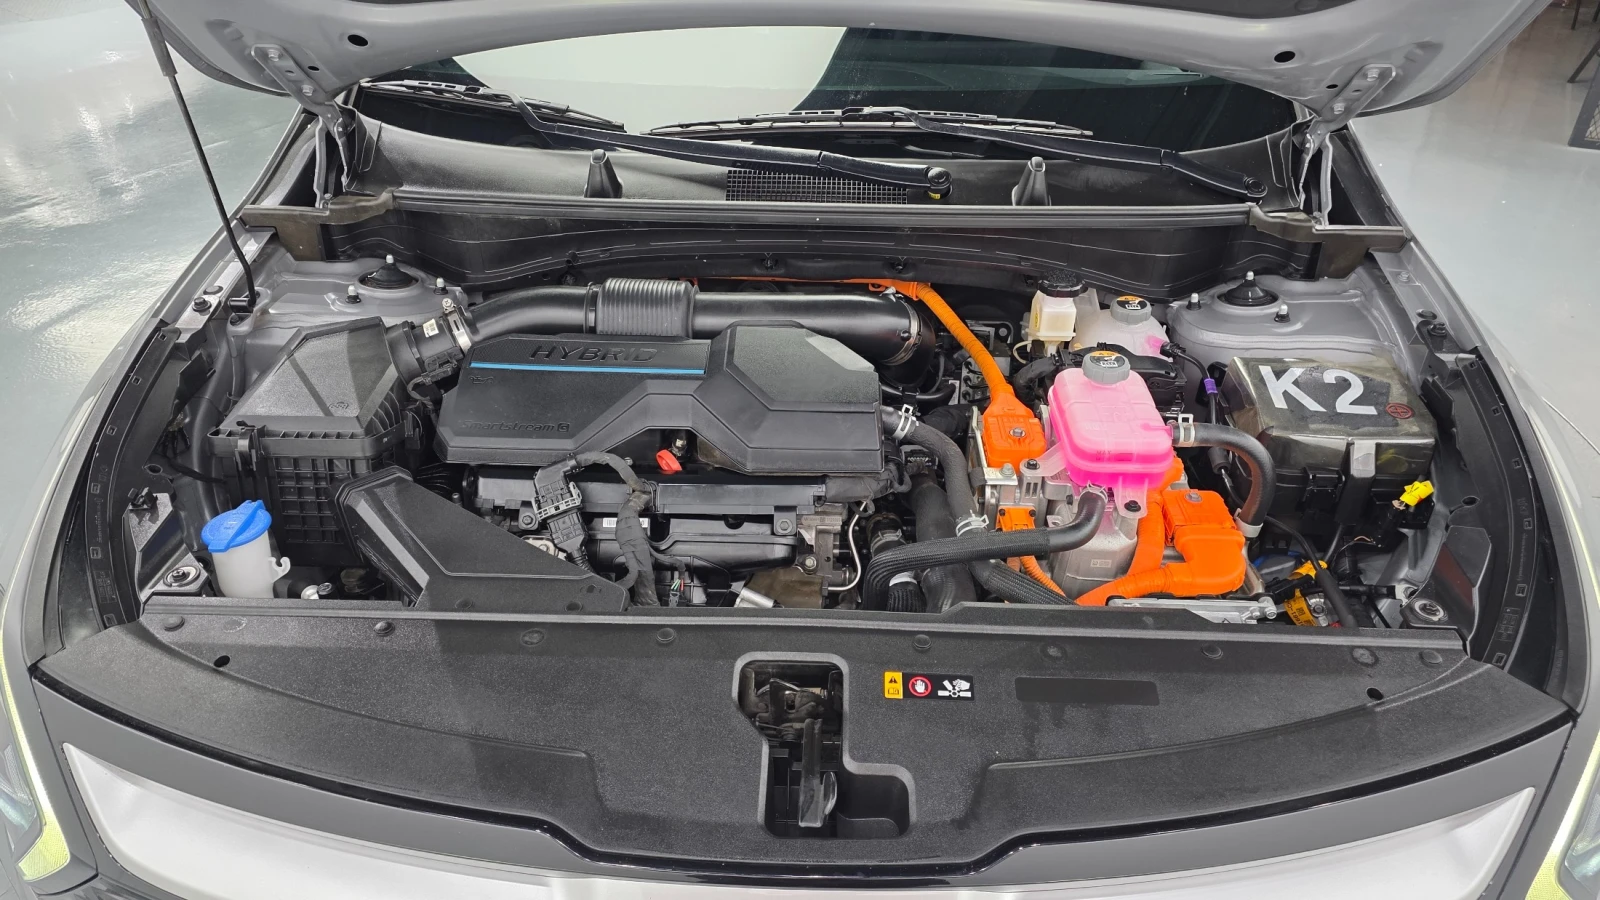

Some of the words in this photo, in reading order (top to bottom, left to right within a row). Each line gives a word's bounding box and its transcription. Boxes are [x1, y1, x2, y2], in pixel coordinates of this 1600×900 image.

[529, 345, 657, 362] HYBRID
[1258, 365, 1378, 415] K2
[459, 420, 555, 432] Smartstream
